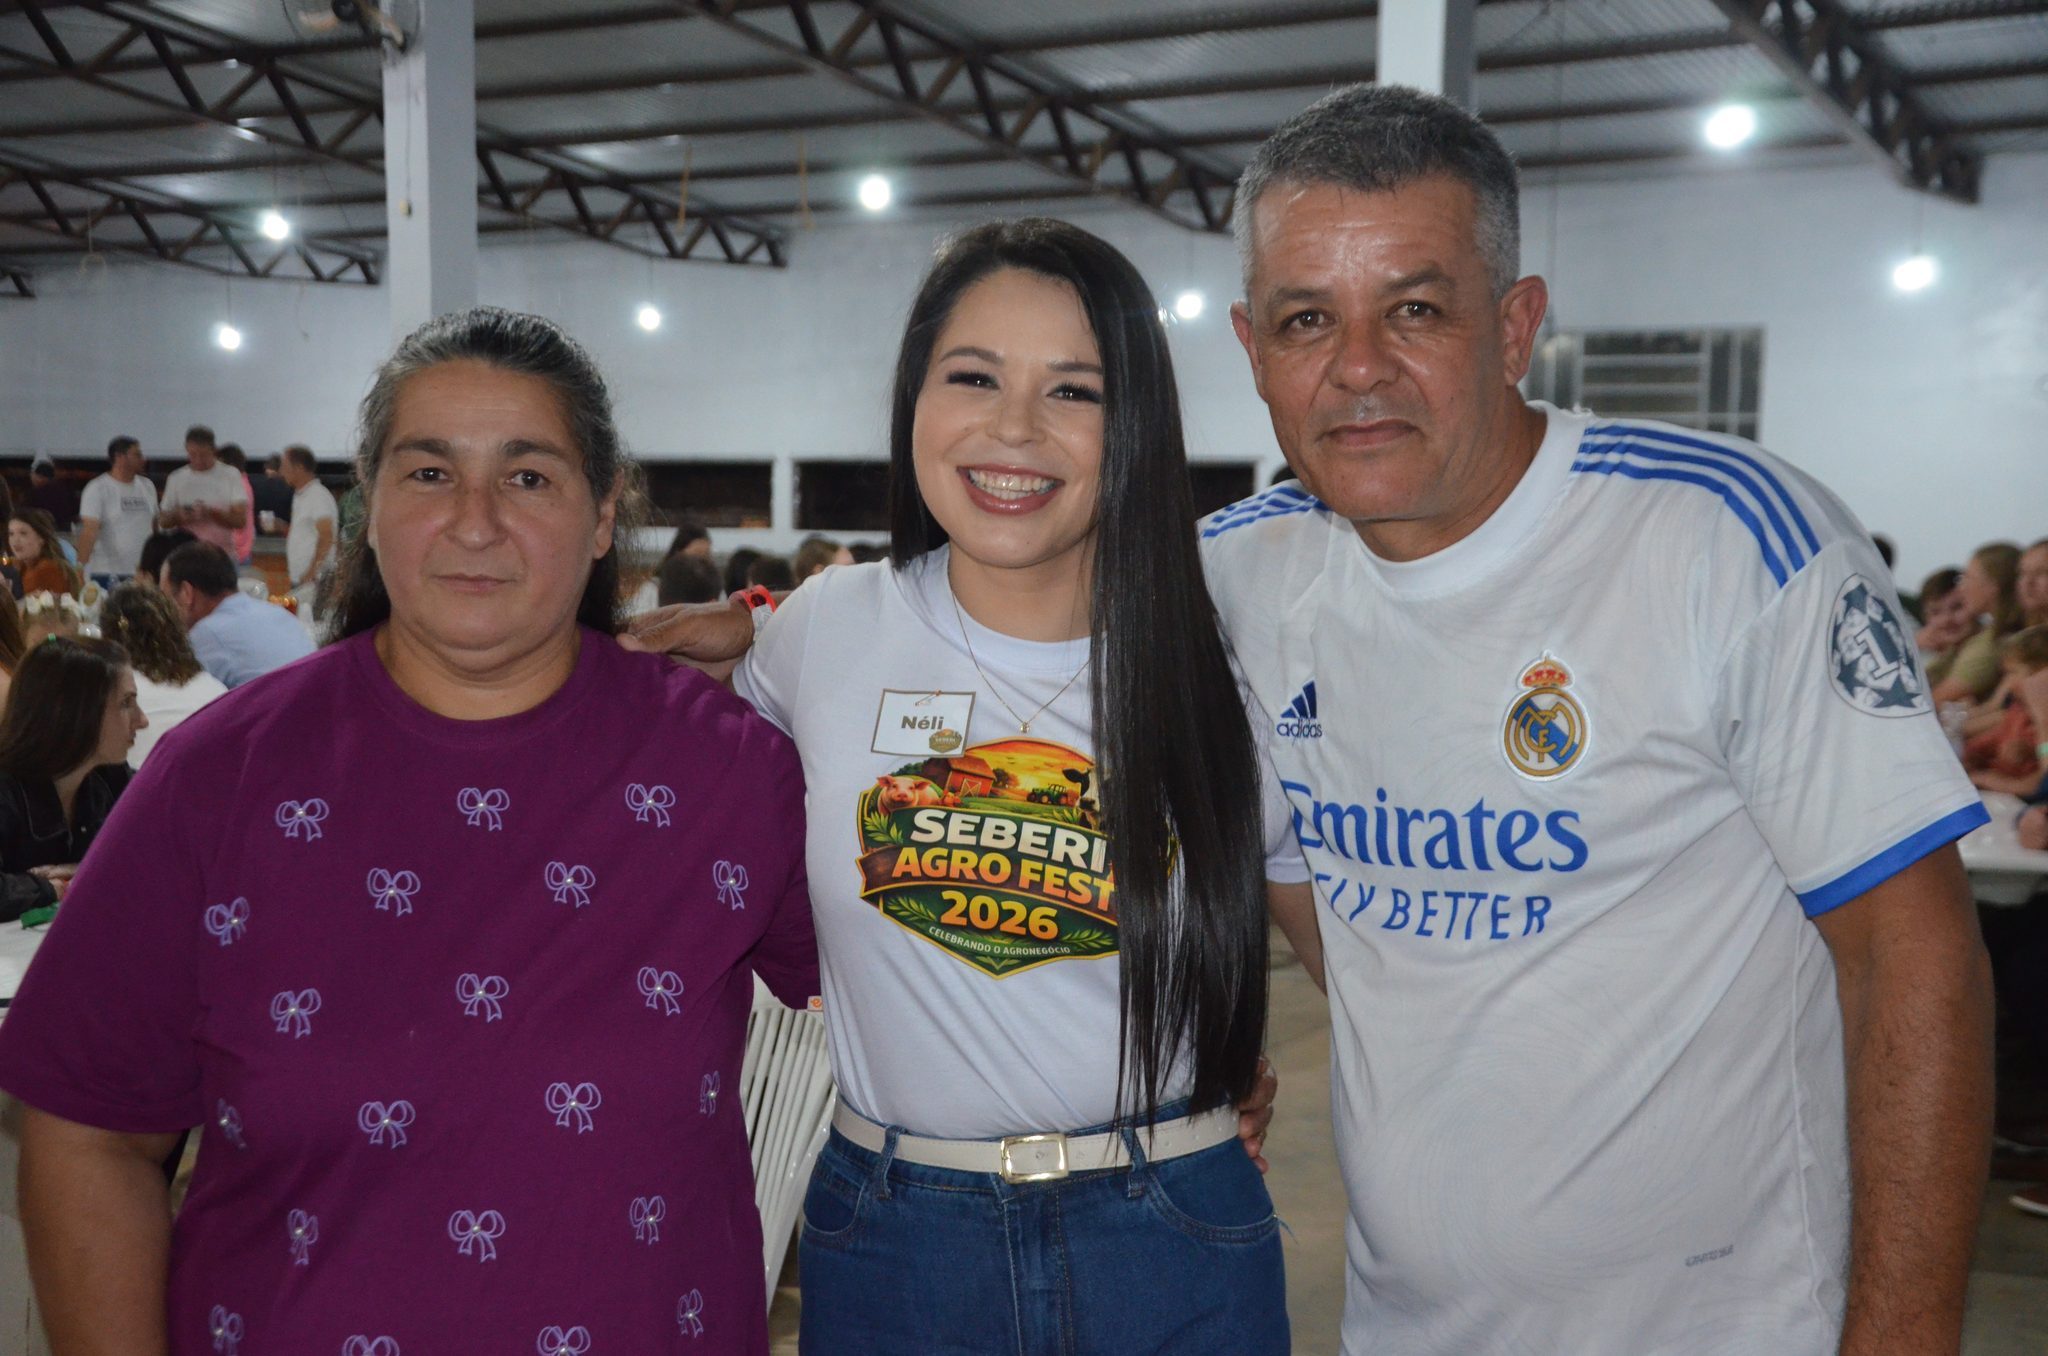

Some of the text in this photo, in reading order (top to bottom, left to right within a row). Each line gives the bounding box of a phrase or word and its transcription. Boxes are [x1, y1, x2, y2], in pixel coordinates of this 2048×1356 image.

[901, 715, 944, 729] Néli
[910, 809, 1107, 873] SEBERI
[892, 847, 1115, 911] AGRO FEST
[940, 890, 1059, 941] 2026
[1381, 888, 1552, 940] BETTER
[929, 926, 992, 953] CELEBRANDO
[994, 943, 1002, 955] O
